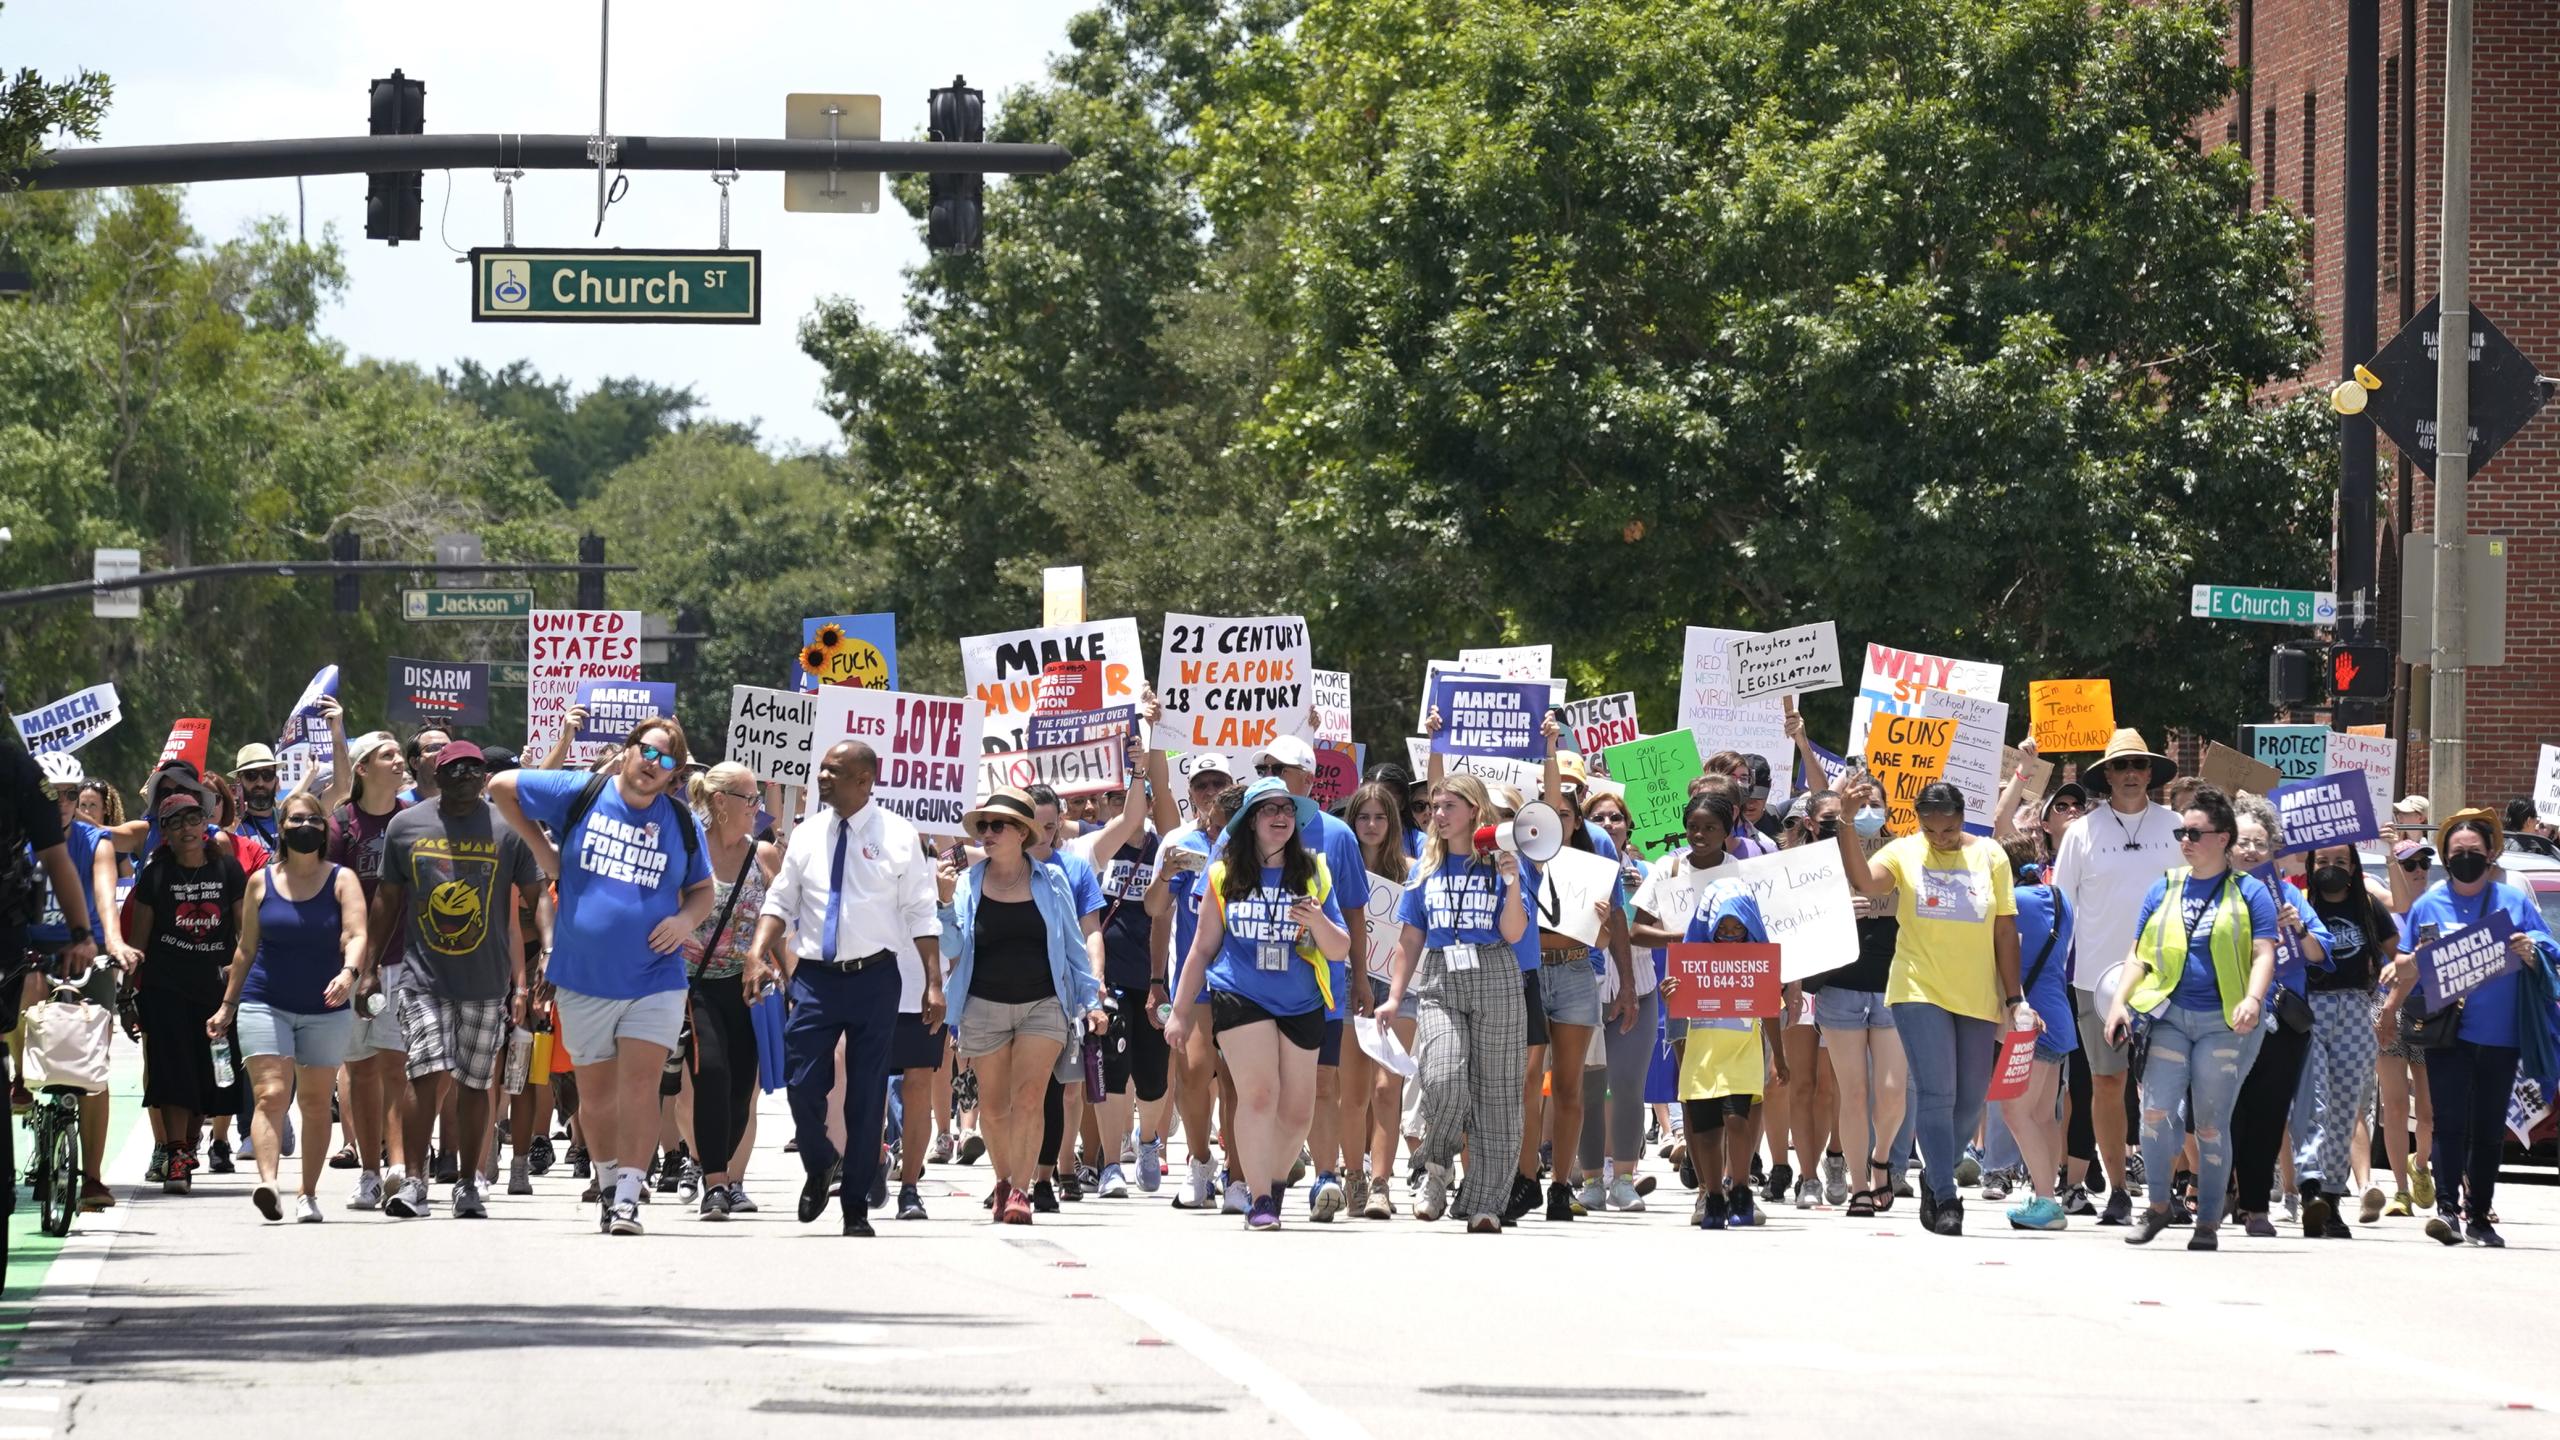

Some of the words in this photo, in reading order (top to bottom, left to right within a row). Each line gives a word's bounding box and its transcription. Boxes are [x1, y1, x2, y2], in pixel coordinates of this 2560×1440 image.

[552, 268, 690, 304] Church
[703, 270, 728, 288] ST
[2423, 331, 2439, 346] FLAS
[2419, 436, 2437, 450] 407-
[436, 595, 509, 613] Jackson
[2212, 591, 2223, 612] E
[2231, 592, 2290, 616] Church
[2297, 602, 2310, 617] St
[533, 613, 624, 634] UNITED
[533, 637, 639, 660] STATES
[1170, 625, 1205, 654] 21
[1218, 623, 1304, 654] CENTURY
[1734, 637, 1791, 657] Thoughts
[1798, 631, 1817, 643] and
[831, 648, 878, 674] FUCK
[995, 632, 1107, 680] MAKE
[1740, 657, 1787, 674] Prayers
[1795, 647, 1815, 662] and
[1869, 643, 1957, 692] WHY
[403, 666, 471, 690] DISARM
[502, 667, 528, 682] Sou
[579, 663, 641, 681] PROVIDE
[1180, 658, 1294, 685] WEAPONS
[1313, 673, 1348, 690] MORE
[1737, 664, 1832, 694] LEGISLATION
[415, 690, 460, 711] HATE
[532, 697, 567, 712] YOUR
[590, 688, 650, 704] MARCH
[1165, 688, 1190, 713] 18
[1205, 684, 1302, 712] CENTURY
[1453, 691, 1521, 710] MARCH
[1932, 690, 1966, 710] School
[1970, 701, 1992, 715] Year
[22, 693, 100, 735] MARCH
[531, 714, 564, 727] THEY
[590, 703, 623, 719] FOR
[624, 705, 659, 720] OUR
[740, 693, 817, 726] Actuall
[1037, 719, 1055, 729] THE
[1055, 715, 1087, 727] FIGHT'S
[1088, 712, 1105, 723] NOT
[1106, 708, 1128, 720] OVER
[1324, 710, 1349, 730] GUN
[1452, 710, 1489, 729] FOR
[1491, 711, 1531, 730] OUR
[1566, 694, 1629, 727] OTECT
[2044, 702, 2095, 716] Teacher
[530, 729, 541, 743] A
[589, 718, 635, 735] LIVES
[734, 724, 788, 749] guns
[846, 710, 886, 736] LETS
[892, 698, 964, 758] LOVE
[1035, 728, 1080, 746] TEXT
[1083, 720, 1131, 742] NEXT
[1192, 715, 1278, 748] LAWS
[1574, 717, 1636, 755] LDREN
[1735, 725, 1788, 739] UNIVERSIT
[1888, 717, 1950, 747] GUNS
[2035, 720, 2058, 734] NOT
[2066, 720, 2074, 731] A
[27, 726, 71, 751] FOR
[1450, 729, 1503, 748] LIVES
[2328, 733, 2357, 751] 250
[2360, 742, 2392, 757] mass
[530, 746, 544, 760] TO
[1637, 745, 1656, 757] OUR
[1873, 751, 1903, 768] ARE
[1912, 754, 1935, 769] THE
[874, 757, 964, 793] LDREN
[1452, 755, 1522, 785] Assault
[1622, 748, 1685, 783] LIVES
[2274, 759, 2317, 775] KIDS
[2332, 752, 2392, 776] Shootings
[1647, 778, 1670, 792] OR
[1647, 791, 1679, 809] YOUR
[1967, 796, 1986, 810] SHOT
[2280, 783, 2341, 812] MARCH
[915, 797, 964, 824] GUNS
[1887, 806, 1917, 824] KIDS
[2281, 806, 2317, 829] FOR
[2318, 799, 2357, 822] OUR
[587, 811, 659, 850] MARCH
[2284, 822, 2336, 846] LIVES
[415, 838, 497, 854] PAC-MAN
[582, 830, 625, 860] FOR
[624, 845, 668, 871] OUR
[580, 850, 635, 883] LIVES
[1785, 865, 1833, 890] Laws
[1228, 902, 1266, 920] FOR
[1425, 892, 1459, 911] FOR
[1462, 892, 1498, 912] OUR
[1229, 920, 1281, 941] LIVES
[1427, 910, 1474, 930] LIVES
[160, 934, 177, 945] END
[2431, 927, 2494, 968] MARCH
[1681, 960, 1708, 973] TEXT
[1710, 960, 1769, 973] GUNSENSE
[2436, 956, 2471, 984] FOR
[2470, 941, 2506, 969] OUR
[1696, 975, 1711, 988] TO
[1713, 975, 1754, 988] 644-33
[2440, 966, 2486, 999] LIVES
